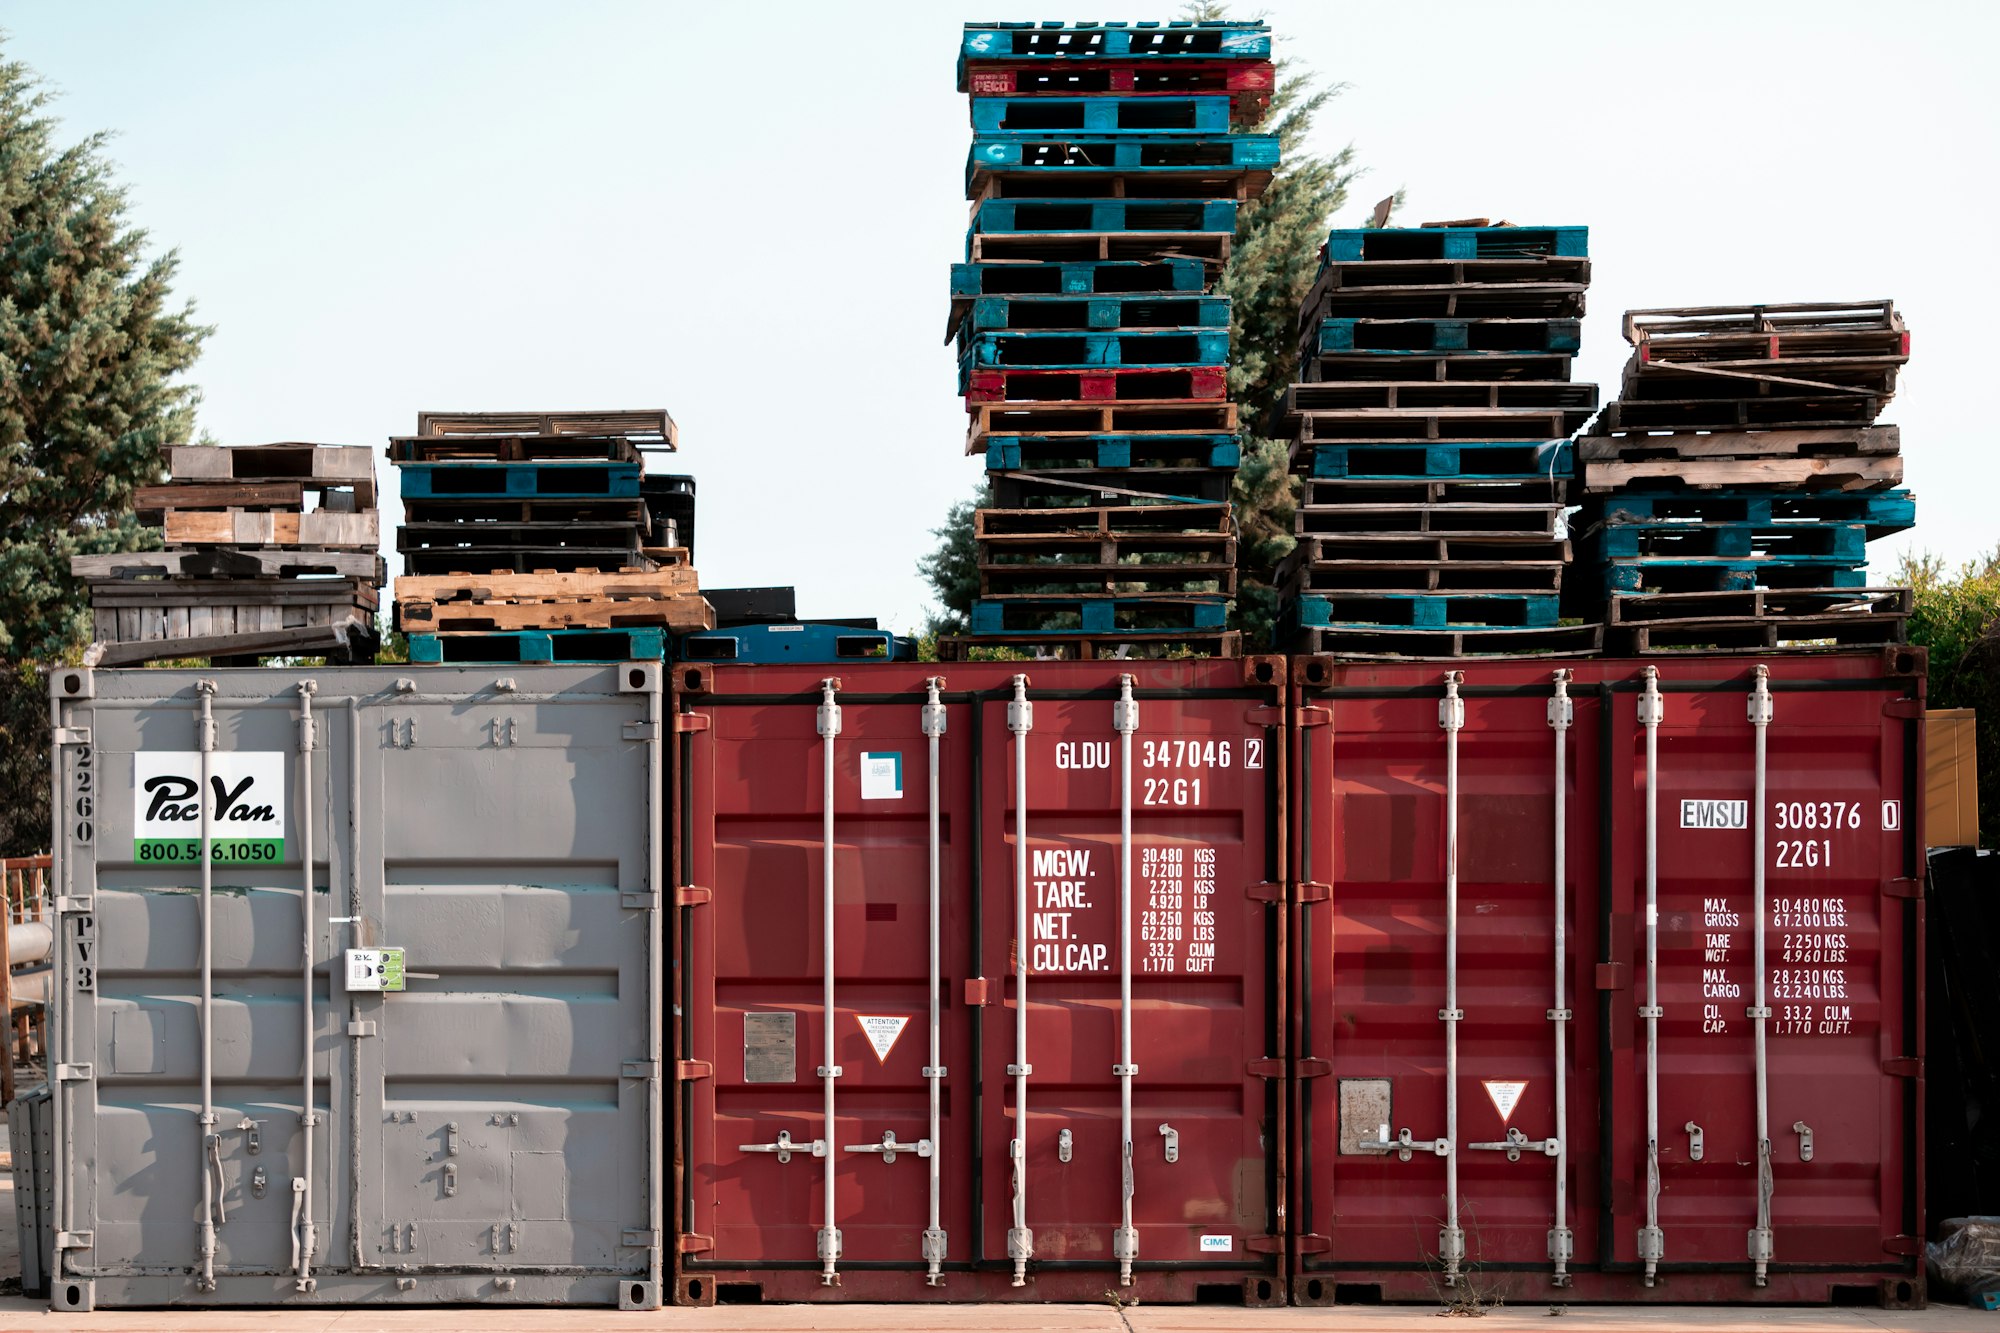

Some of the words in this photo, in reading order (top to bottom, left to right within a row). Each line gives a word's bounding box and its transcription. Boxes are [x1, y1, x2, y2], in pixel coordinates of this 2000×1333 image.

[1056, 742, 1110, 769] GLDU
[1143, 741, 1230, 767] 347046
[1247, 741, 1260, 767] 2
[144, 776, 199, 821] Pac
[211, 776, 275, 821] Van
[1144, 778, 1200, 805] 22G1
[1684, 801, 1745, 828] EMSU
[1775, 802, 1860, 829] 308376
[141, 843, 276, 860] 800.56.1050
[1143, 848, 1182, 862] 30,480
[1194, 849, 1215, 863] KGS
[1777, 840, 1830, 867] 22G1
[1034, 850, 1095, 877] MGW.
[1142, 863, 1182, 877] 67,200
[1194, 864, 1215, 878] LBS
[1034, 881, 1092, 908] TARE.
[1150, 880, 1182, 894] 2,230
[1194, 880, 1215, 894] KGS
[1150, 895, 1182, 909] 4,920
[1194, 895, 1207, 909] LB
[1704, 899, 1730, 912] MAX.
[1774, 899, 1819, 913] 30,480
[1823, 899, 1846, 913] KGS.
[1142, 911, 1182, 925] 28,250
[1194, 911, 1214, 925] KGS
[1705, 913, 1738, 926] GROSS
[1774, 914, 1820, 927] 67,200
[1823, 914, 1848, 927] LBS.
[1034, 913, 1077, 939] NET.
[1142, 926, 1182, 940] 62,280
[1194, 927, 1214, 940] LBS
[1706, 934, 1730, 948] TARE
[1784, 934, 1821, 948] 2,250
[1825, 934, 1848, 948] KGS.
[1034, 944, 1108, 971] CU.CAP.
[1150, 943, 1174, 957] 33.2
[1190, 943, 1214, 957] CU.M
[1706, 949, 1729, 962] WGT.
[1783, 950, 1820, 962] 4,960
[1824, 950, 1847, 962] LBS.
[1143, 958, 1174, 972] 1,170
[1186, 958, 1214, 972] CU.FT
[1703, 969, 1729, 983] MAX.
[1773, 970, 1819, 984] 28,230
[1823, 970, 1846, 984] KGS.
[1704, 984, 1740, 998] CARGO
[1774, 985, 1820, 998] 62,240
[1823, 985, 1848, 998] LBS.
[1704, 1005, 1721, 1019] CU.
[1784, 1006, 1811, 1020] 33.2
[1825, 1006, 1852, 1020] CU.M.
[1704, 1020, 1727, 1033] CAP.
[1776, 1021, 1811, 1033] 1,170
[1819, 1021, 1850, 1034] CU.FT.
[1203, 1238, 1230, 1246] CIMC
